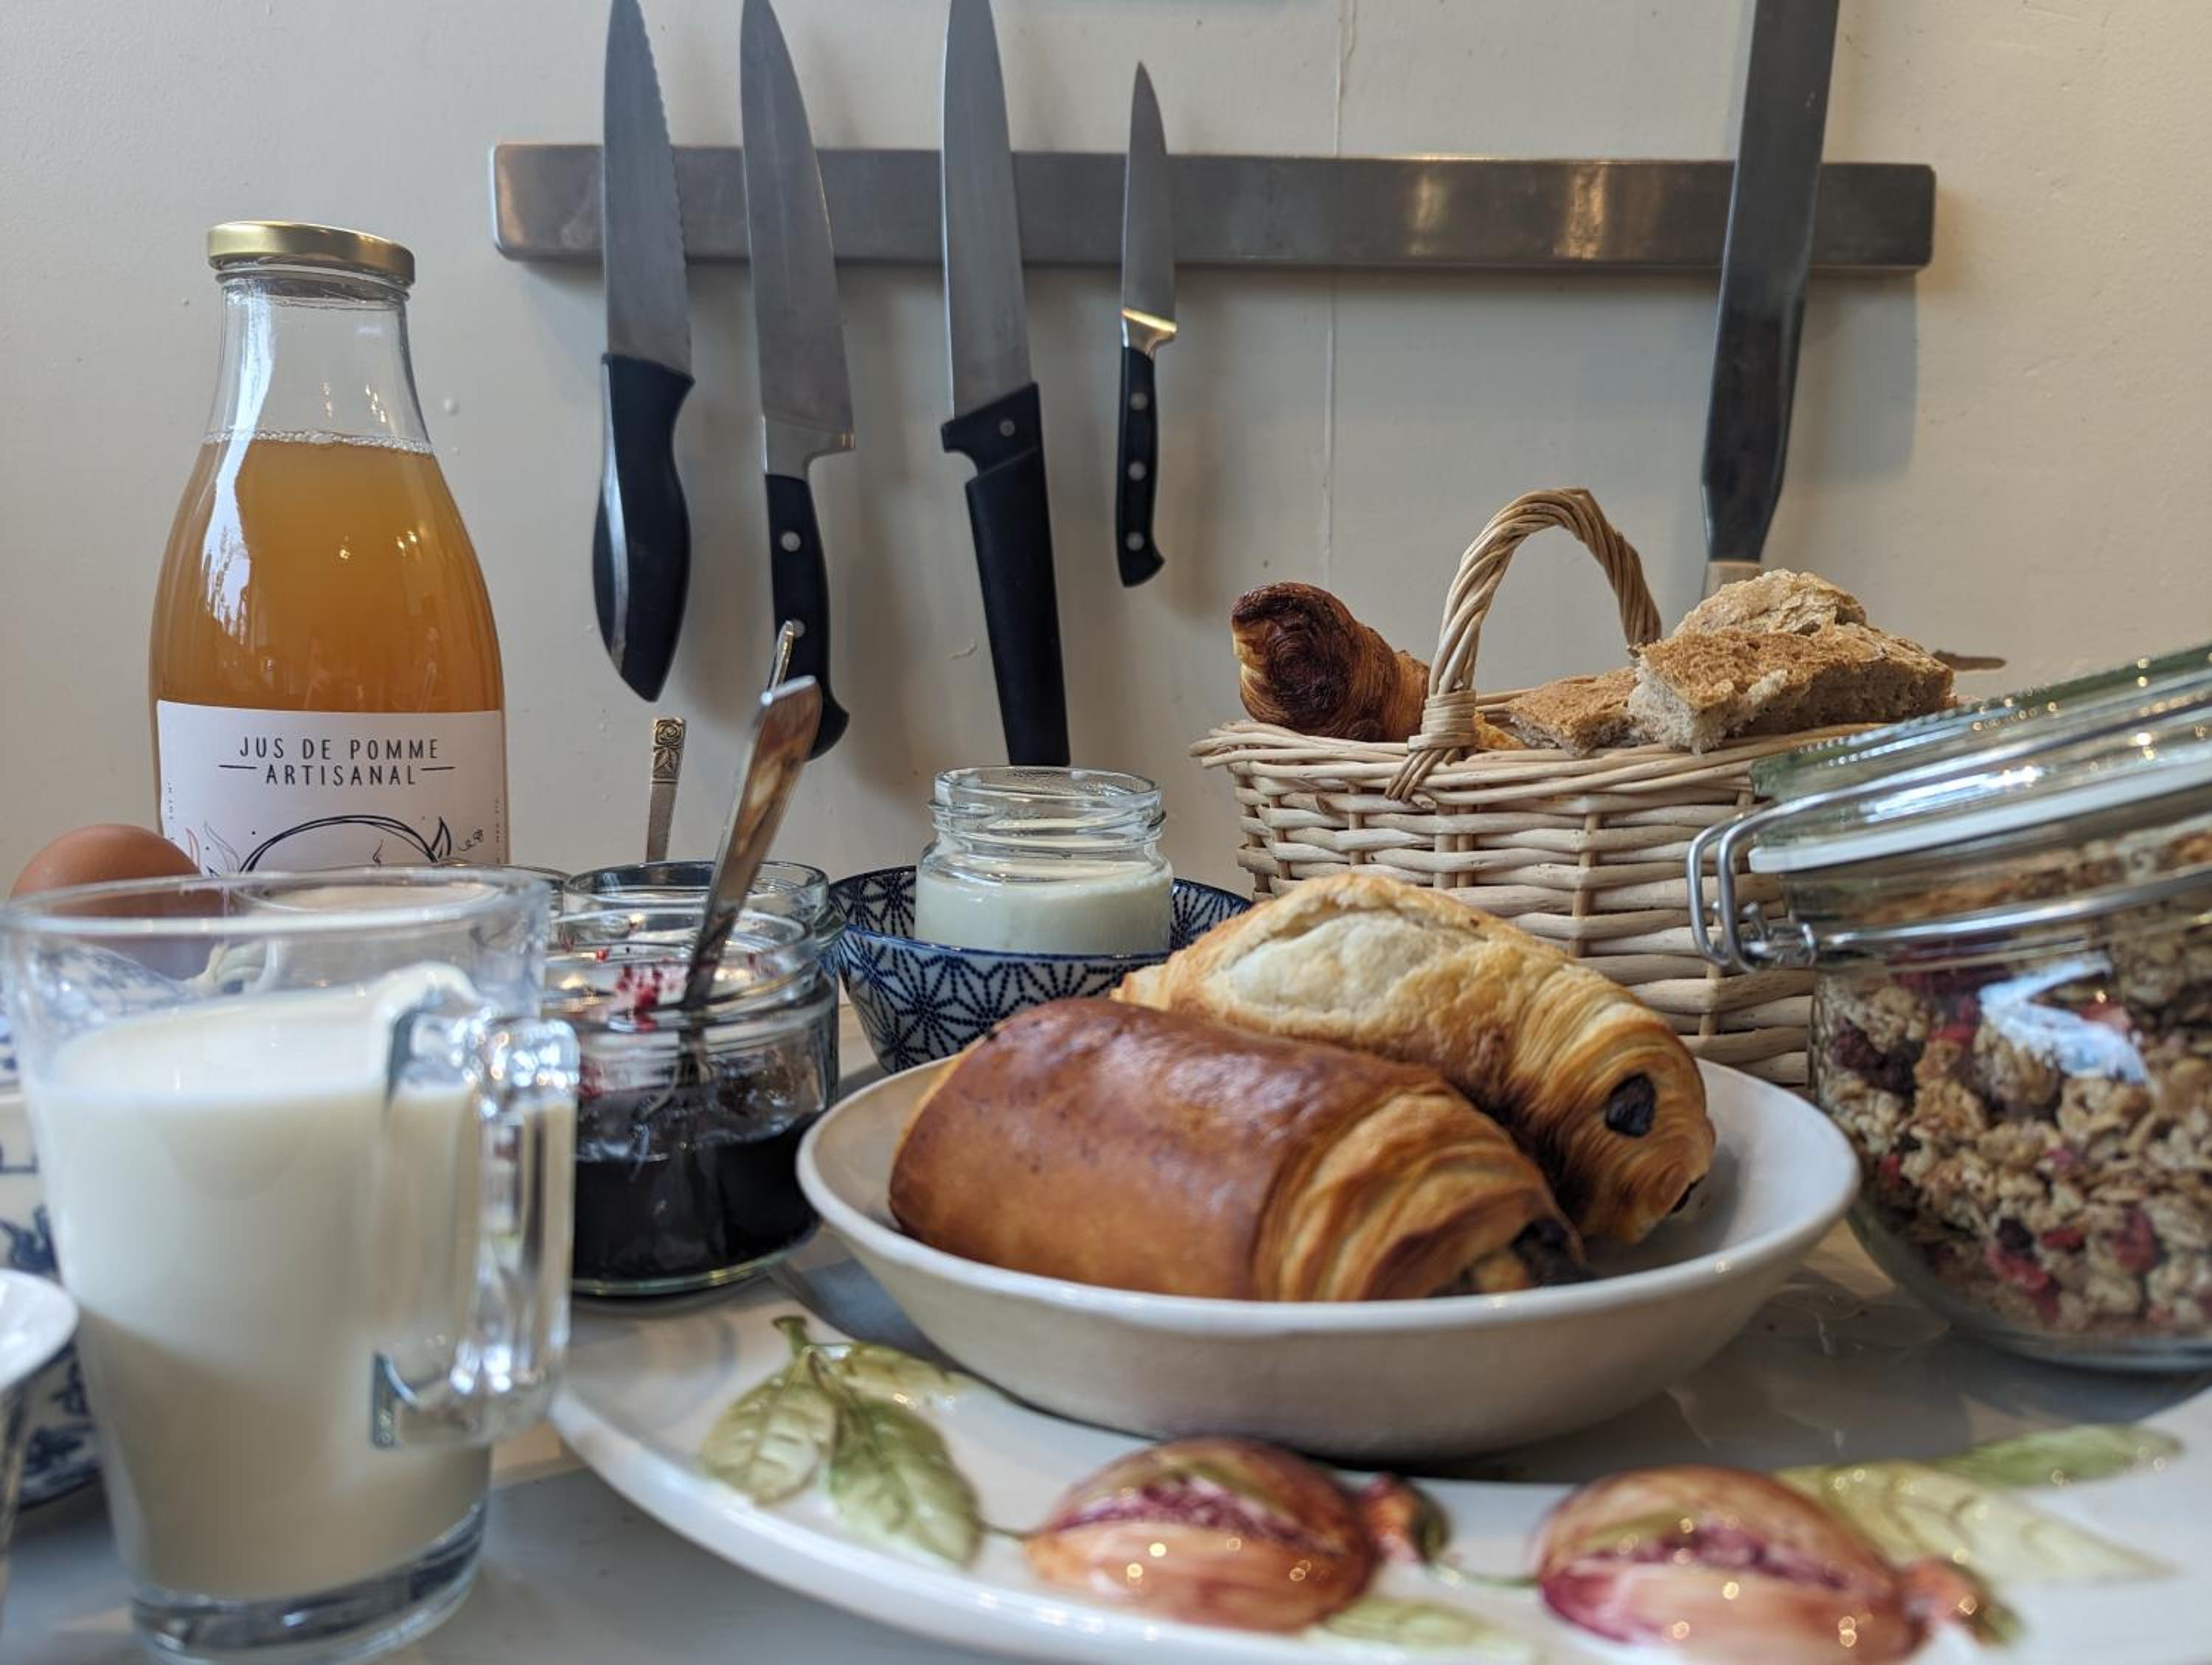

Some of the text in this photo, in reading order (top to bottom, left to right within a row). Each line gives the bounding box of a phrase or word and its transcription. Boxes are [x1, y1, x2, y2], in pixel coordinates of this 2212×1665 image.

[239, 737, 438, 760] JUS DE POMME
[265, 763, 416, 787] ARTISANAL
